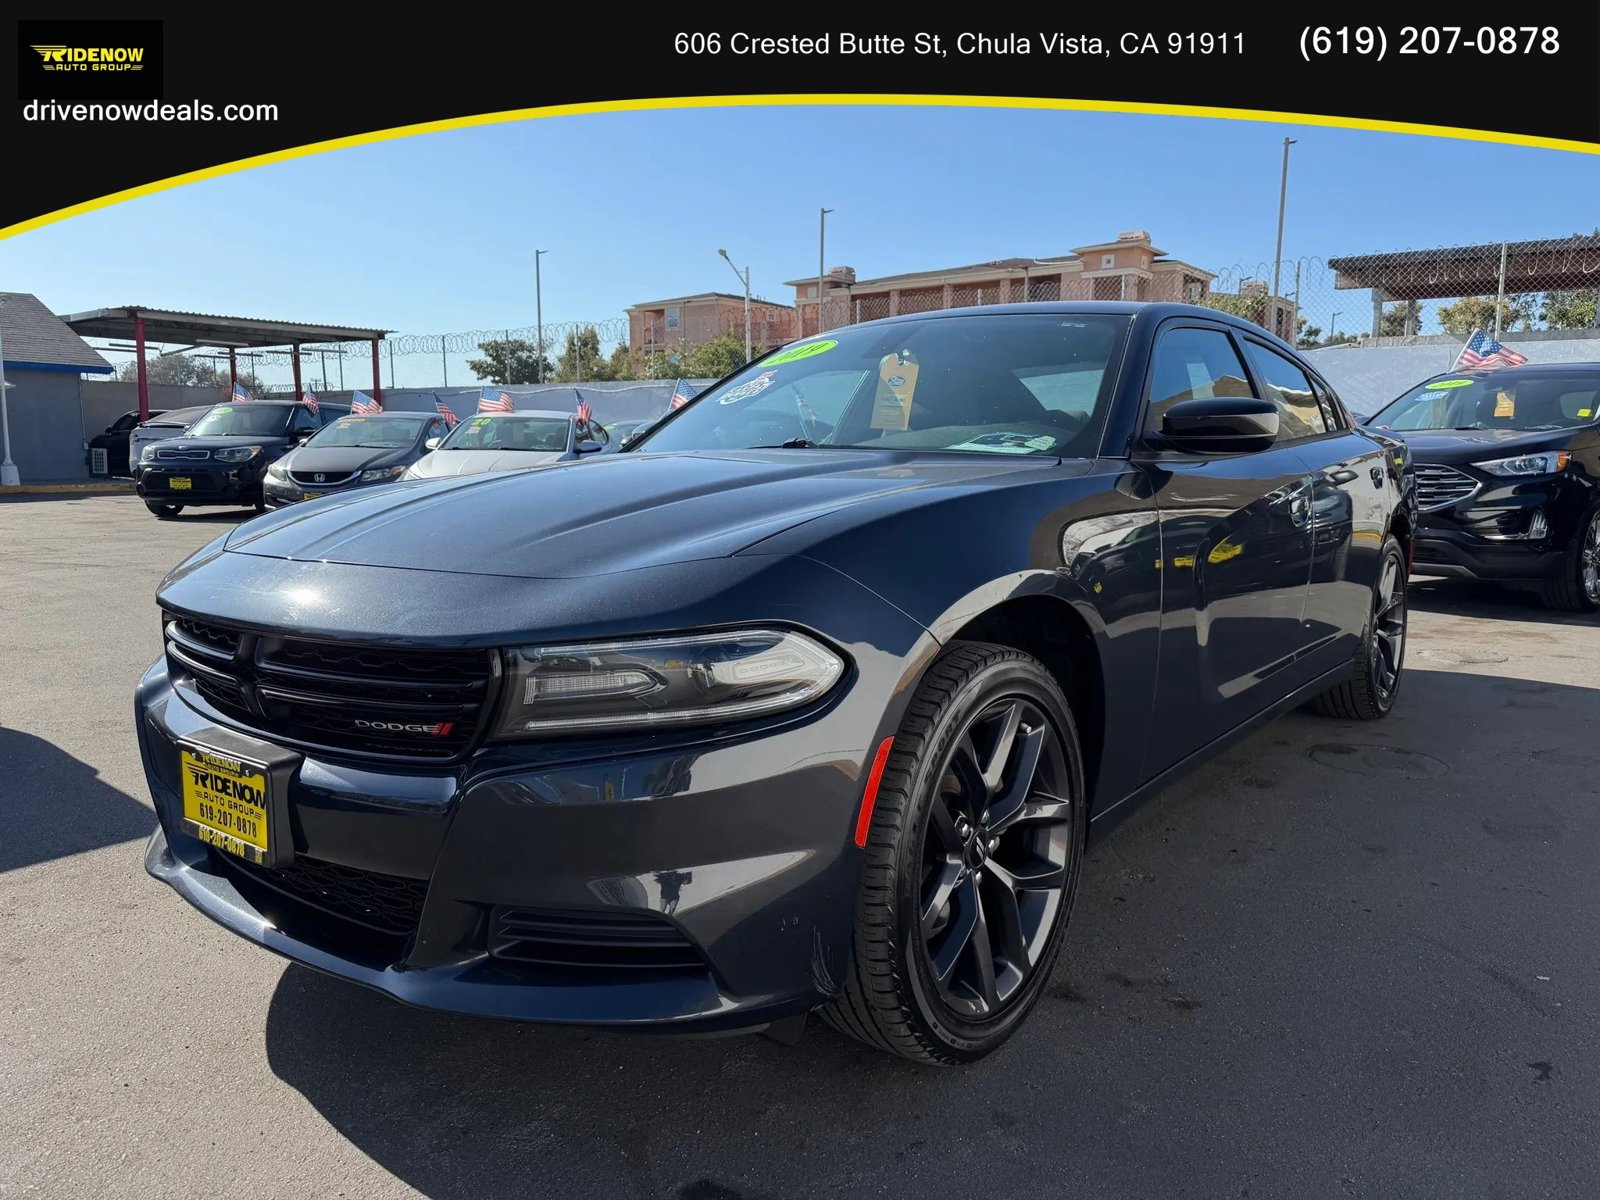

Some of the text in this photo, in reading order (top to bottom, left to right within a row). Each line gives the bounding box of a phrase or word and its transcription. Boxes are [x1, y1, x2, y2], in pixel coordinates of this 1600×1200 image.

[355, 720, 440, 732] DODGE
[187, 763, 267, 810] RIDENOW
[203, 791, 254, 816] AUTO GROUP
[199, 803, 257, 838] 619-207-0878
